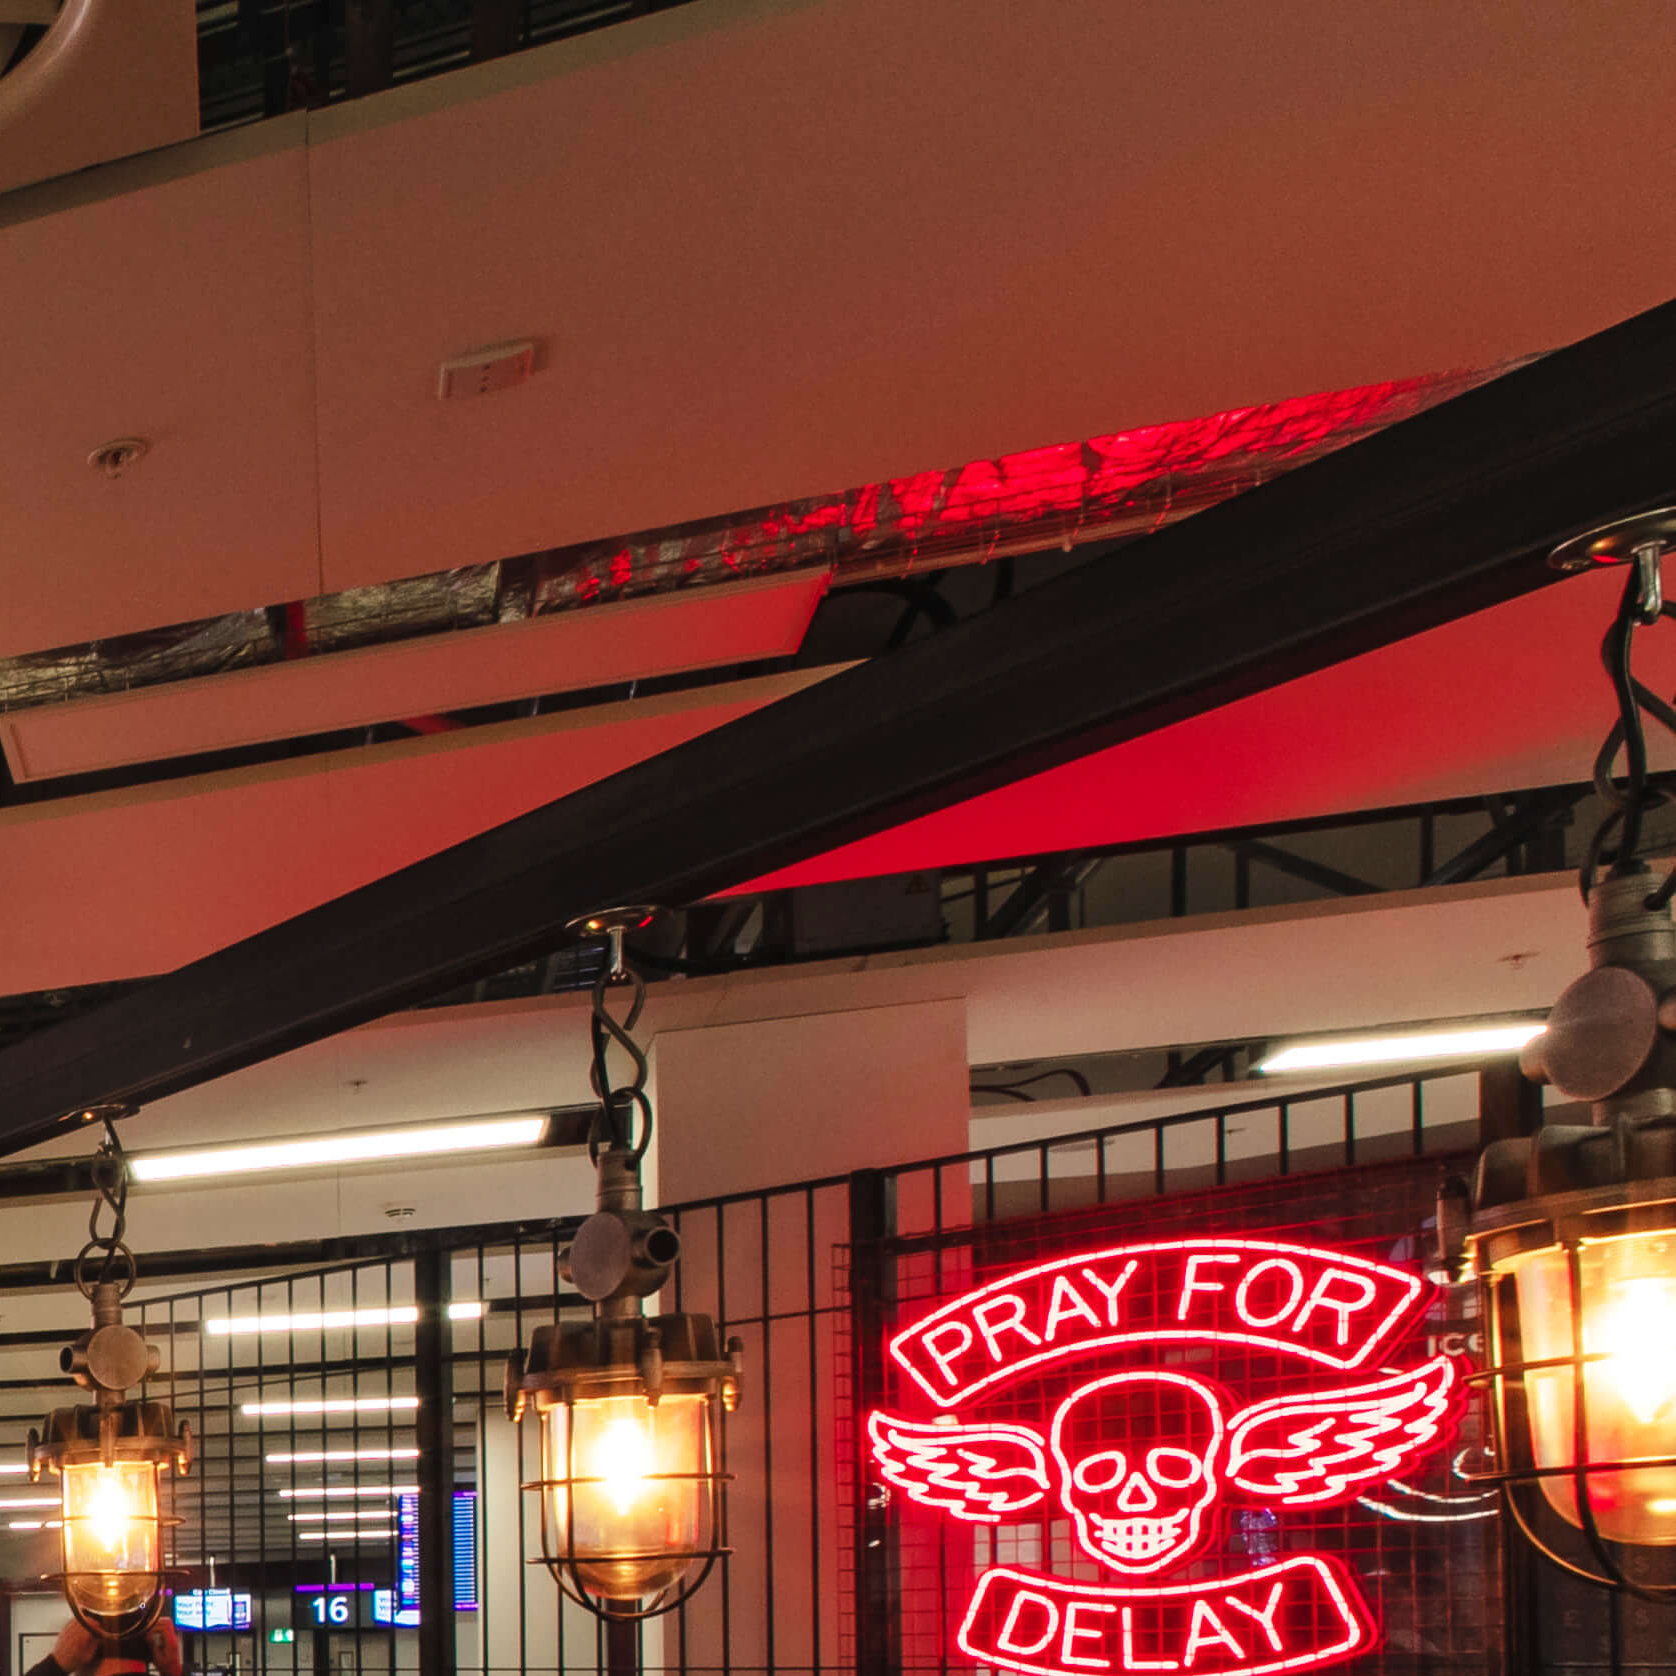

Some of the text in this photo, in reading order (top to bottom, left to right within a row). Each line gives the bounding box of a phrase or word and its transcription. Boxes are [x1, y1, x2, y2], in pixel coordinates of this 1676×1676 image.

[919, 1253, 1378, 1388] PRAY FOR
[312, 1595, 350, 1625] 16
[996, 1582, 1285, 1672] DELAY
